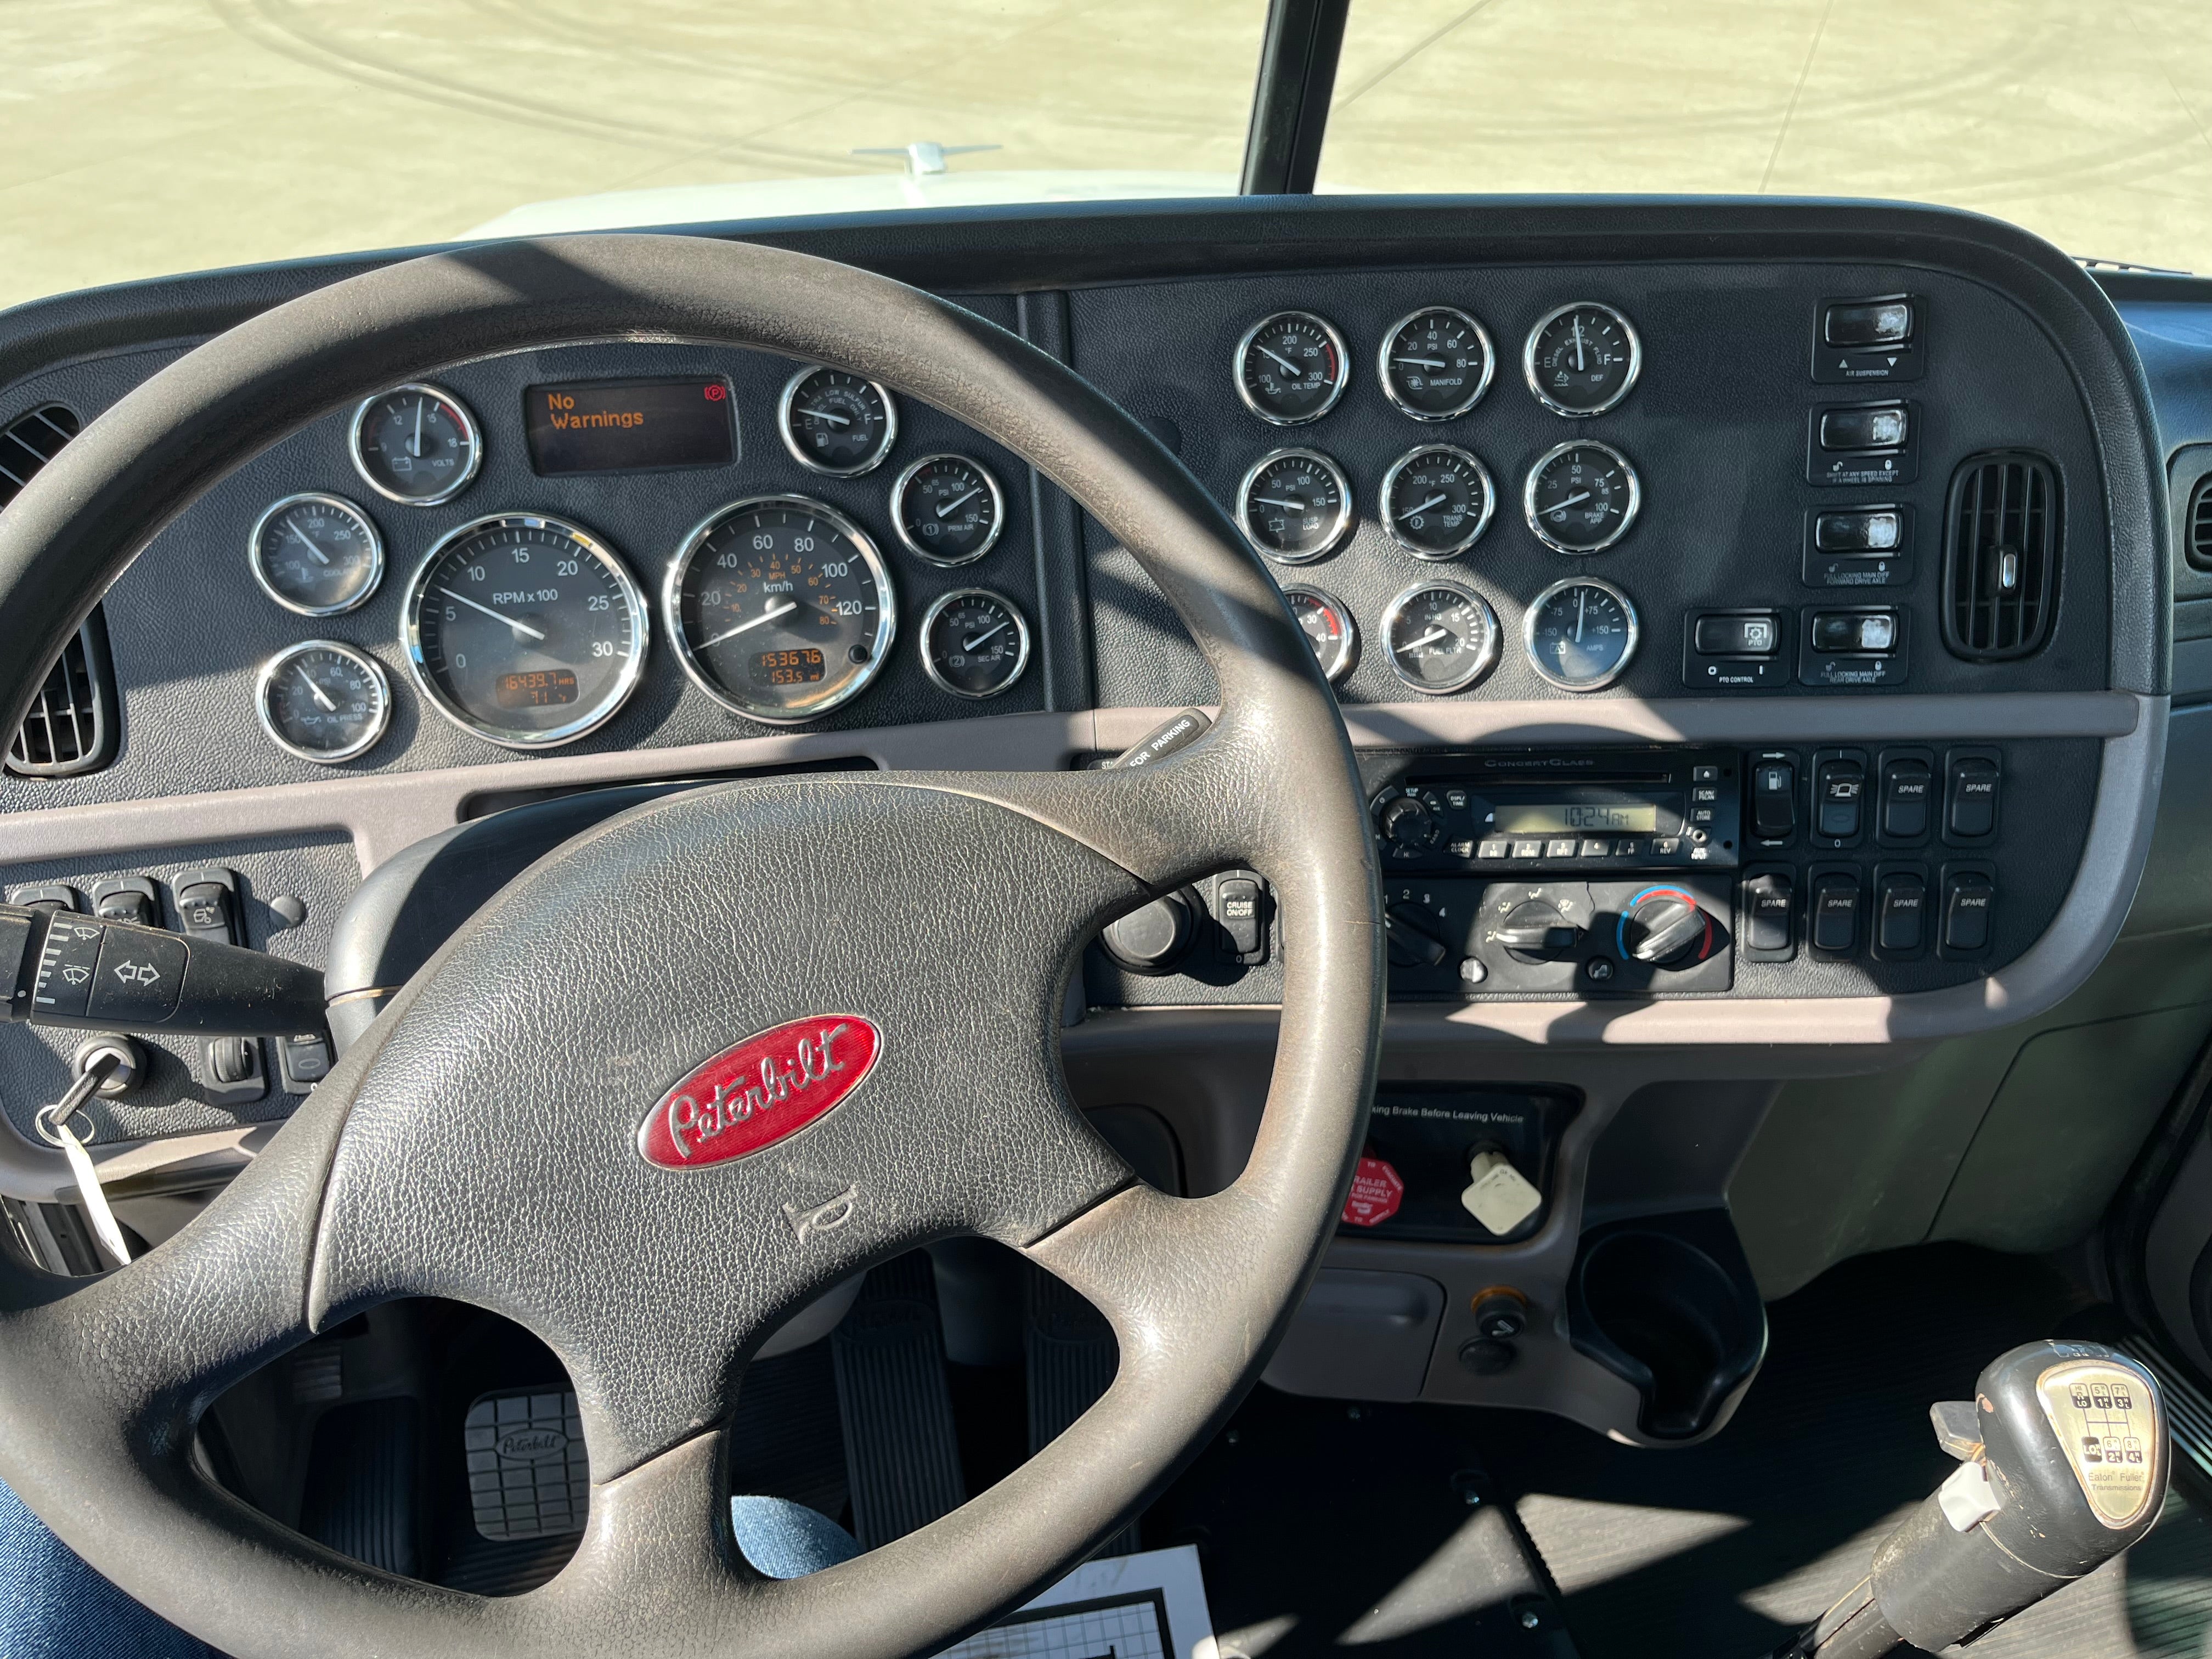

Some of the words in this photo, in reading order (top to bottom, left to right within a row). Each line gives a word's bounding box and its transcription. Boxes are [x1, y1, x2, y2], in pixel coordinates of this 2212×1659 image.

[1427, 331, 1437, 340] 40
[1283, 336, 1297, 345] 200
[1447, 340, 1457, 348] 60
[1408, 342, 1417, 351] 20
[1304, 348, 1318, 357] 250
[1457, 359, 1466, 368] 80
[1544, 358, 1551, 368] E
[1604, 354, 1611, 365] F
[1399, 362, 1403, 370] 0
[1259, 375, 1271, 383] 100
[1308, 372, 1323, 381] 300
[549, 393, 575, 410] No
[393, 415, 403, 425] 12
[427, 414, 437, 423] 15
[551, 410, 644, 430] Warnings
[864, 414, 871, 425] F
[805, 419, 812, 430] E
[448, 437, 458, 448] 18
[432, 458, 455, 467] VOLTS
[1571, 465, 1581, 474] 50
[1297, 476, 1311, 485] 100
[1413, 475, 1427, 484] 200
[1441, 474, 1454, 483] 250
[1594, 479, 1605, 487] 75
[951, 483, 964, 492] 100
[1272, 479, 1281, 488] 50
[1548, 481, 1558, 489] 25
[923, 485, 932, 494] 50
[1312, 498, 1325, 507] 150
[1595, 503, 1608, 511] 100
[1260, 505, 1265, 513] 0
[1452, 504, 1466, 513] 300
[966, 514, 978, 522] 150
[307, 518, 325, 529] 200
[286, 535, 301, 544] 150
[334, 530, 351, 540] 250
[753, 535, 773, 550] 60
[794, 538, 814, 552] 80
[512, 548, 530, 563] 15
[285, 560, 300, 571] 100
[717, 554, 737, 568] 40
[770, 561, 780, 570] 40
[467, 565, 486, 582] 10
[557, 561, 578, 577] 20
[751, 569, 761, 578] 30
[791, 565, 801, 574] 50
[822, 563, 848, 578] 100
[769, 572, 786, 580] MPH
[808, 577, 819, 586] 60
[737, 584, 747, 593] 20
[763, 581, 793, 594] km/h
[493, 591, 526, 605] RPM
[527, 594, 535, 602] x
[537, 589, 558, 602] 100
[701, 591, 721, 606] 20
[819, 596, 829, 605] 70
[588, 596, 610, 611] 25
[1429, 602, 1437, 611] 10
[1573, 599, 1578, 607] 0
[731, 604, 741, 612] 10
[836, 601, 862, 616] 120
[1585, 606, 1598, 615] +75
[445, 606, 456, 621] 5
[1451, 613, 1460, 622] 15
[820, 617, 830, 625] 80
[950, 618, 959, 627] 50
[978, 615, 990, 624] 100
[1307, 615, 1317, 624] 30
[1406, 616, 1411, 624] 5
[1593, 625, 1609, 634] +150
[1316, 633, 1326, 642] 40
[1455, 638, 1465, 647] 20
[592, 641, 613, 657] 30
[991, 646, 1003, 654] 150
[456, 654, 466, 668] 0
[330, 667, 342, 676] 60
[350, 680, 361, 690] 80
[558, 678, 574, 686] HRS
[292, 686, 303, 696] 20
[531, 691, 548, 704] 71
[351, 702, 366, 712] 100
[294, 710, 299, 719] 0
[1130, 751, 1150, 767] FOR
[1151, 719, 1190, 751] PARKING
[1898, 785, 1924, 794] SPARE
[1966, 784, 1991, 793] SPARE
[1403, 889, 1409, 899] 2
[1762, 899, 1786, 908] SPARE
[1828, 899, 1853, 908] SPARE
[1894, 899, 1918, 907] SPARE
[1961, 899, 1986, 907] SPARE
[668, 1023, 848, 1159] Peterbilt
[1372, 1105, 1390, 1115] king
[1392, 1106, 1418, 1116] Brake
[1421, 1108, 1450, 1118] Before
[1453, 1110, 1488, 1122] Leaving
[1490, 1112, 1523, 1123] Vehicle
[1353, 1175, 1387, 1187] RAILER
[1357, 1185, 1392, 1197] SUPPLY
[2097, 1398, 2103, 1407] 1
[2118, 1398, 2124, 1407] 3
[2108, 1453, 2115, 1461] 2
[2129, 1453, 2135, 1462] 4
